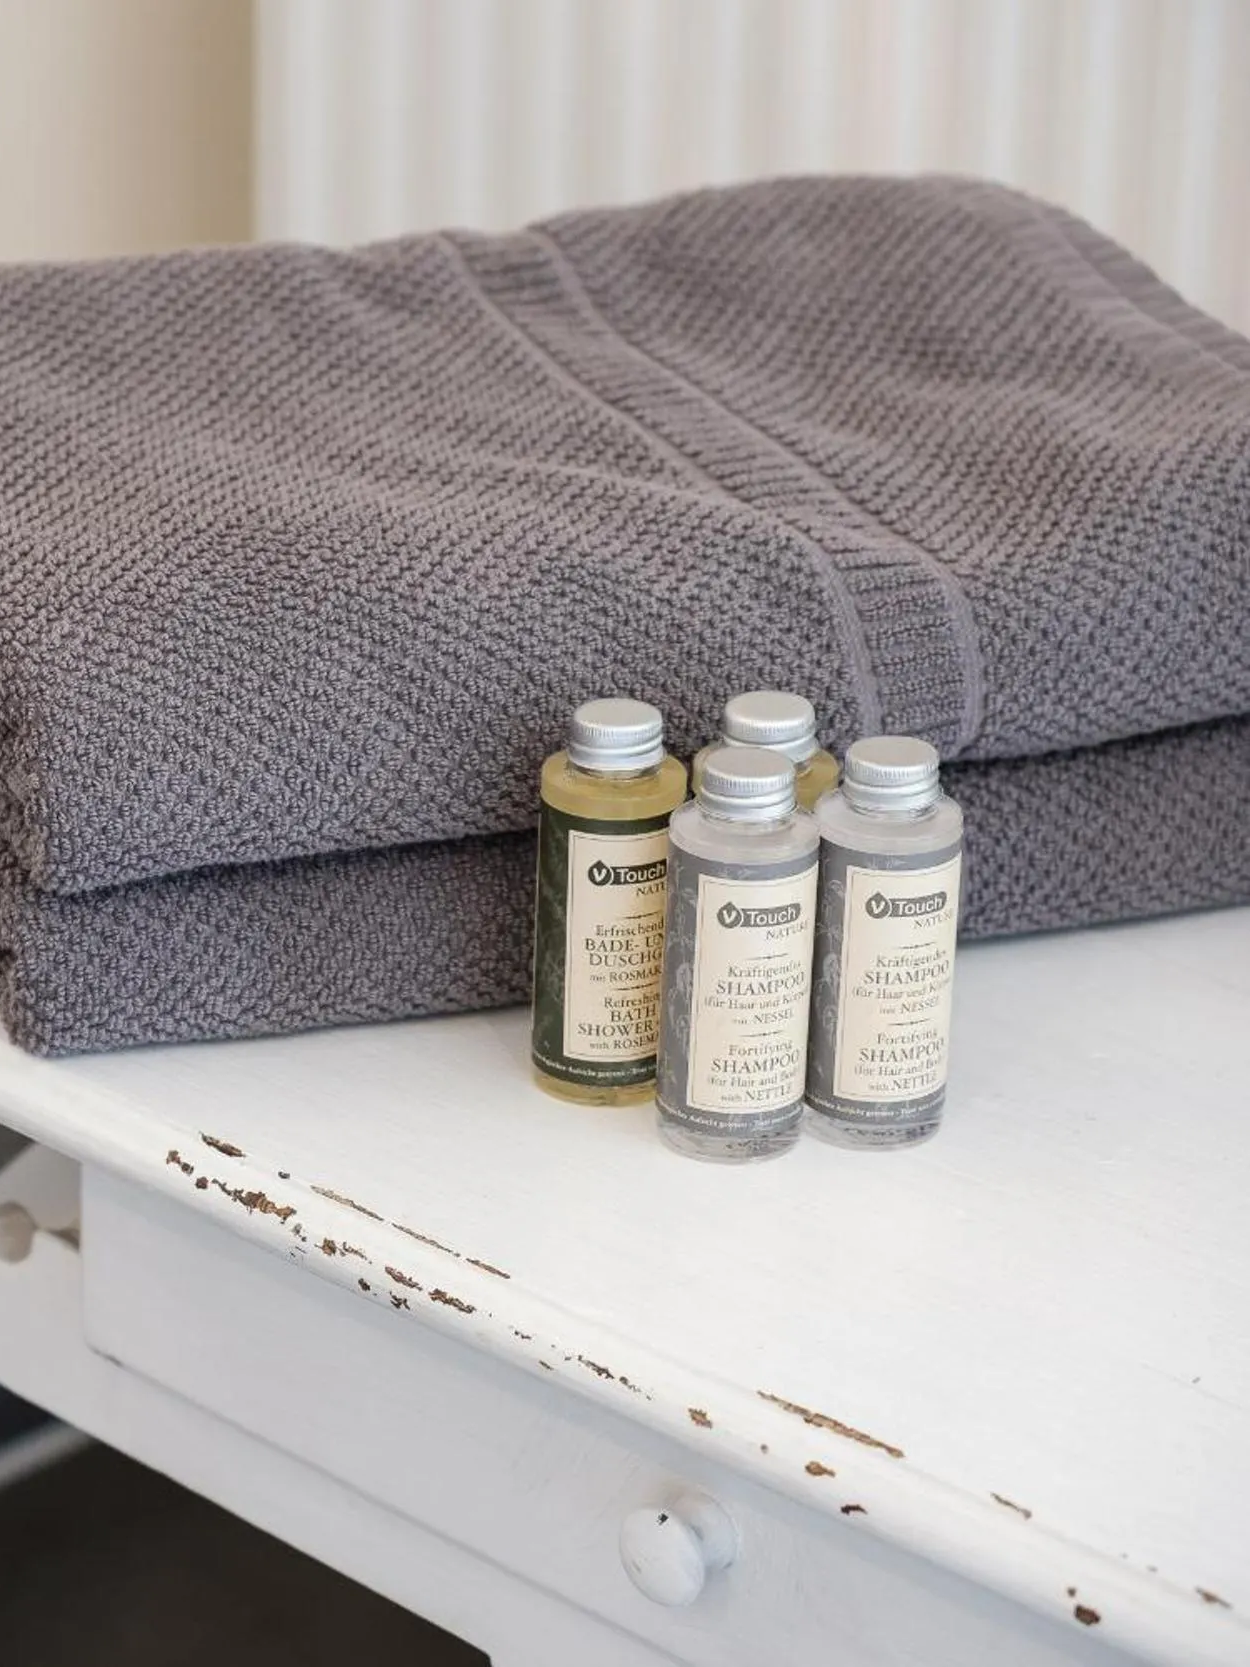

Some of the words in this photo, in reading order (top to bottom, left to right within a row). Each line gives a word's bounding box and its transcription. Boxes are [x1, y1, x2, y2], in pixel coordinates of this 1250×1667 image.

[616, 863, 665, 882] Touch
[895, 896, 943, 915] Touch
[747, 907, 796, 925] Touch
[585, 938, 640, 953] BADE-
[864, 959, 950, 985] SHAMPOO
[716, 971, 805, 996] SHAMPOO
[611, 1003, 656, 1023] BATH
[577, 1019, 653, 1037] SHOWER
[859, 1036, 945, 1062] SHAMPOO
[711, 1049, 800, 1073] SHAMPOO
